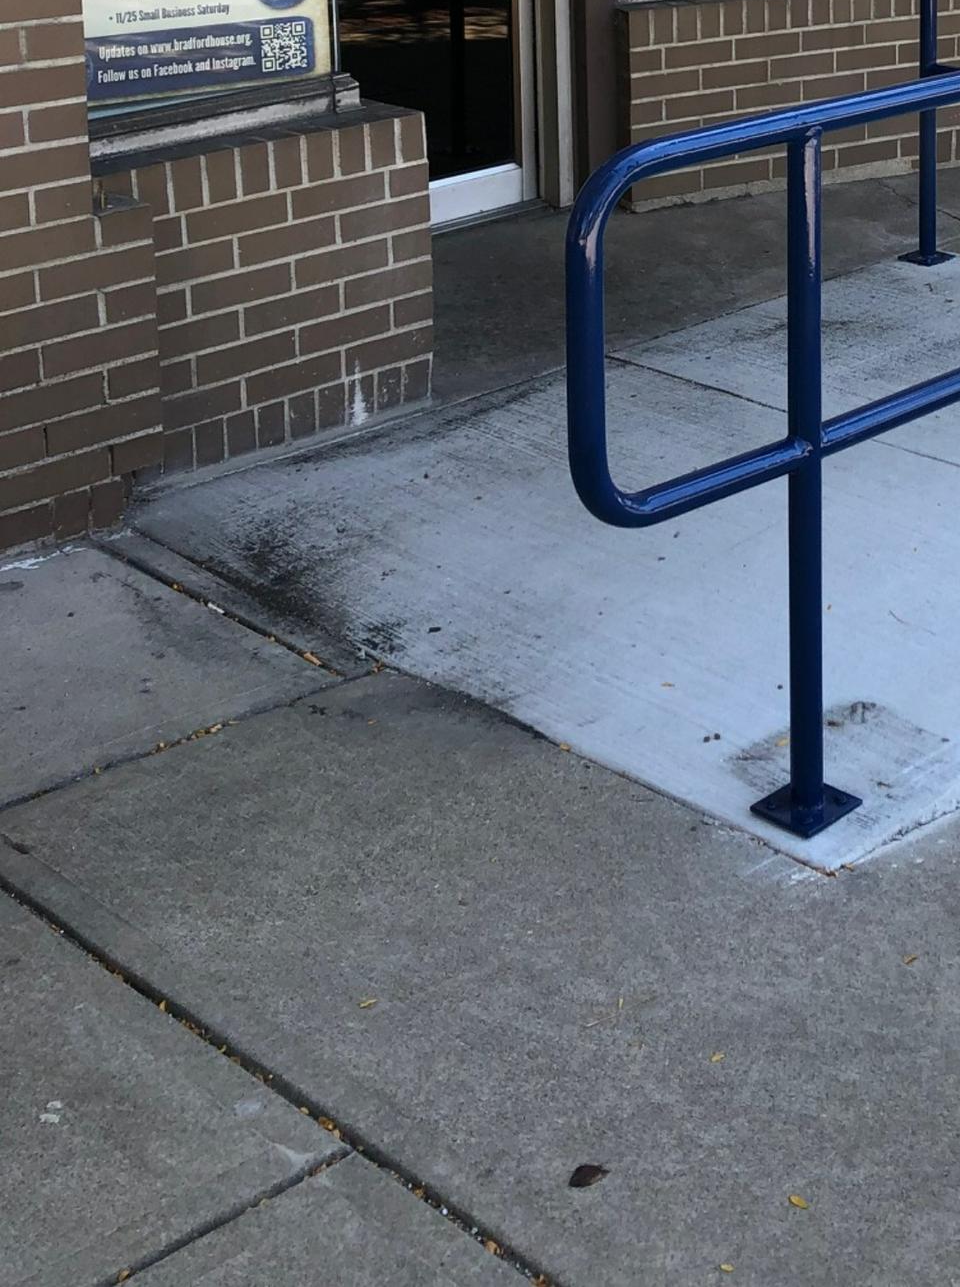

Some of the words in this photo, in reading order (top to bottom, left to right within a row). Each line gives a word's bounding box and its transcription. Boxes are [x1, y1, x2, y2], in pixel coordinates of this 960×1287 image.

[116, 9, 138, 24] 11/25
[138, 8, 160, 21] Small
[161, 6, 195, 19] Business
[196, 3, 230, 17] Saturday
[98, 45, 136, 62] Updates
[137, 45, 149, 56] on
[97, 68, 127, 83] Follow
[128, 69, 139, 80] us
[141, 67, 152, 78] on
[153, 61, 193, 77] Facebook
[195, 58, 211, 71] and
[212, 55, 257, 70] Instagram.
